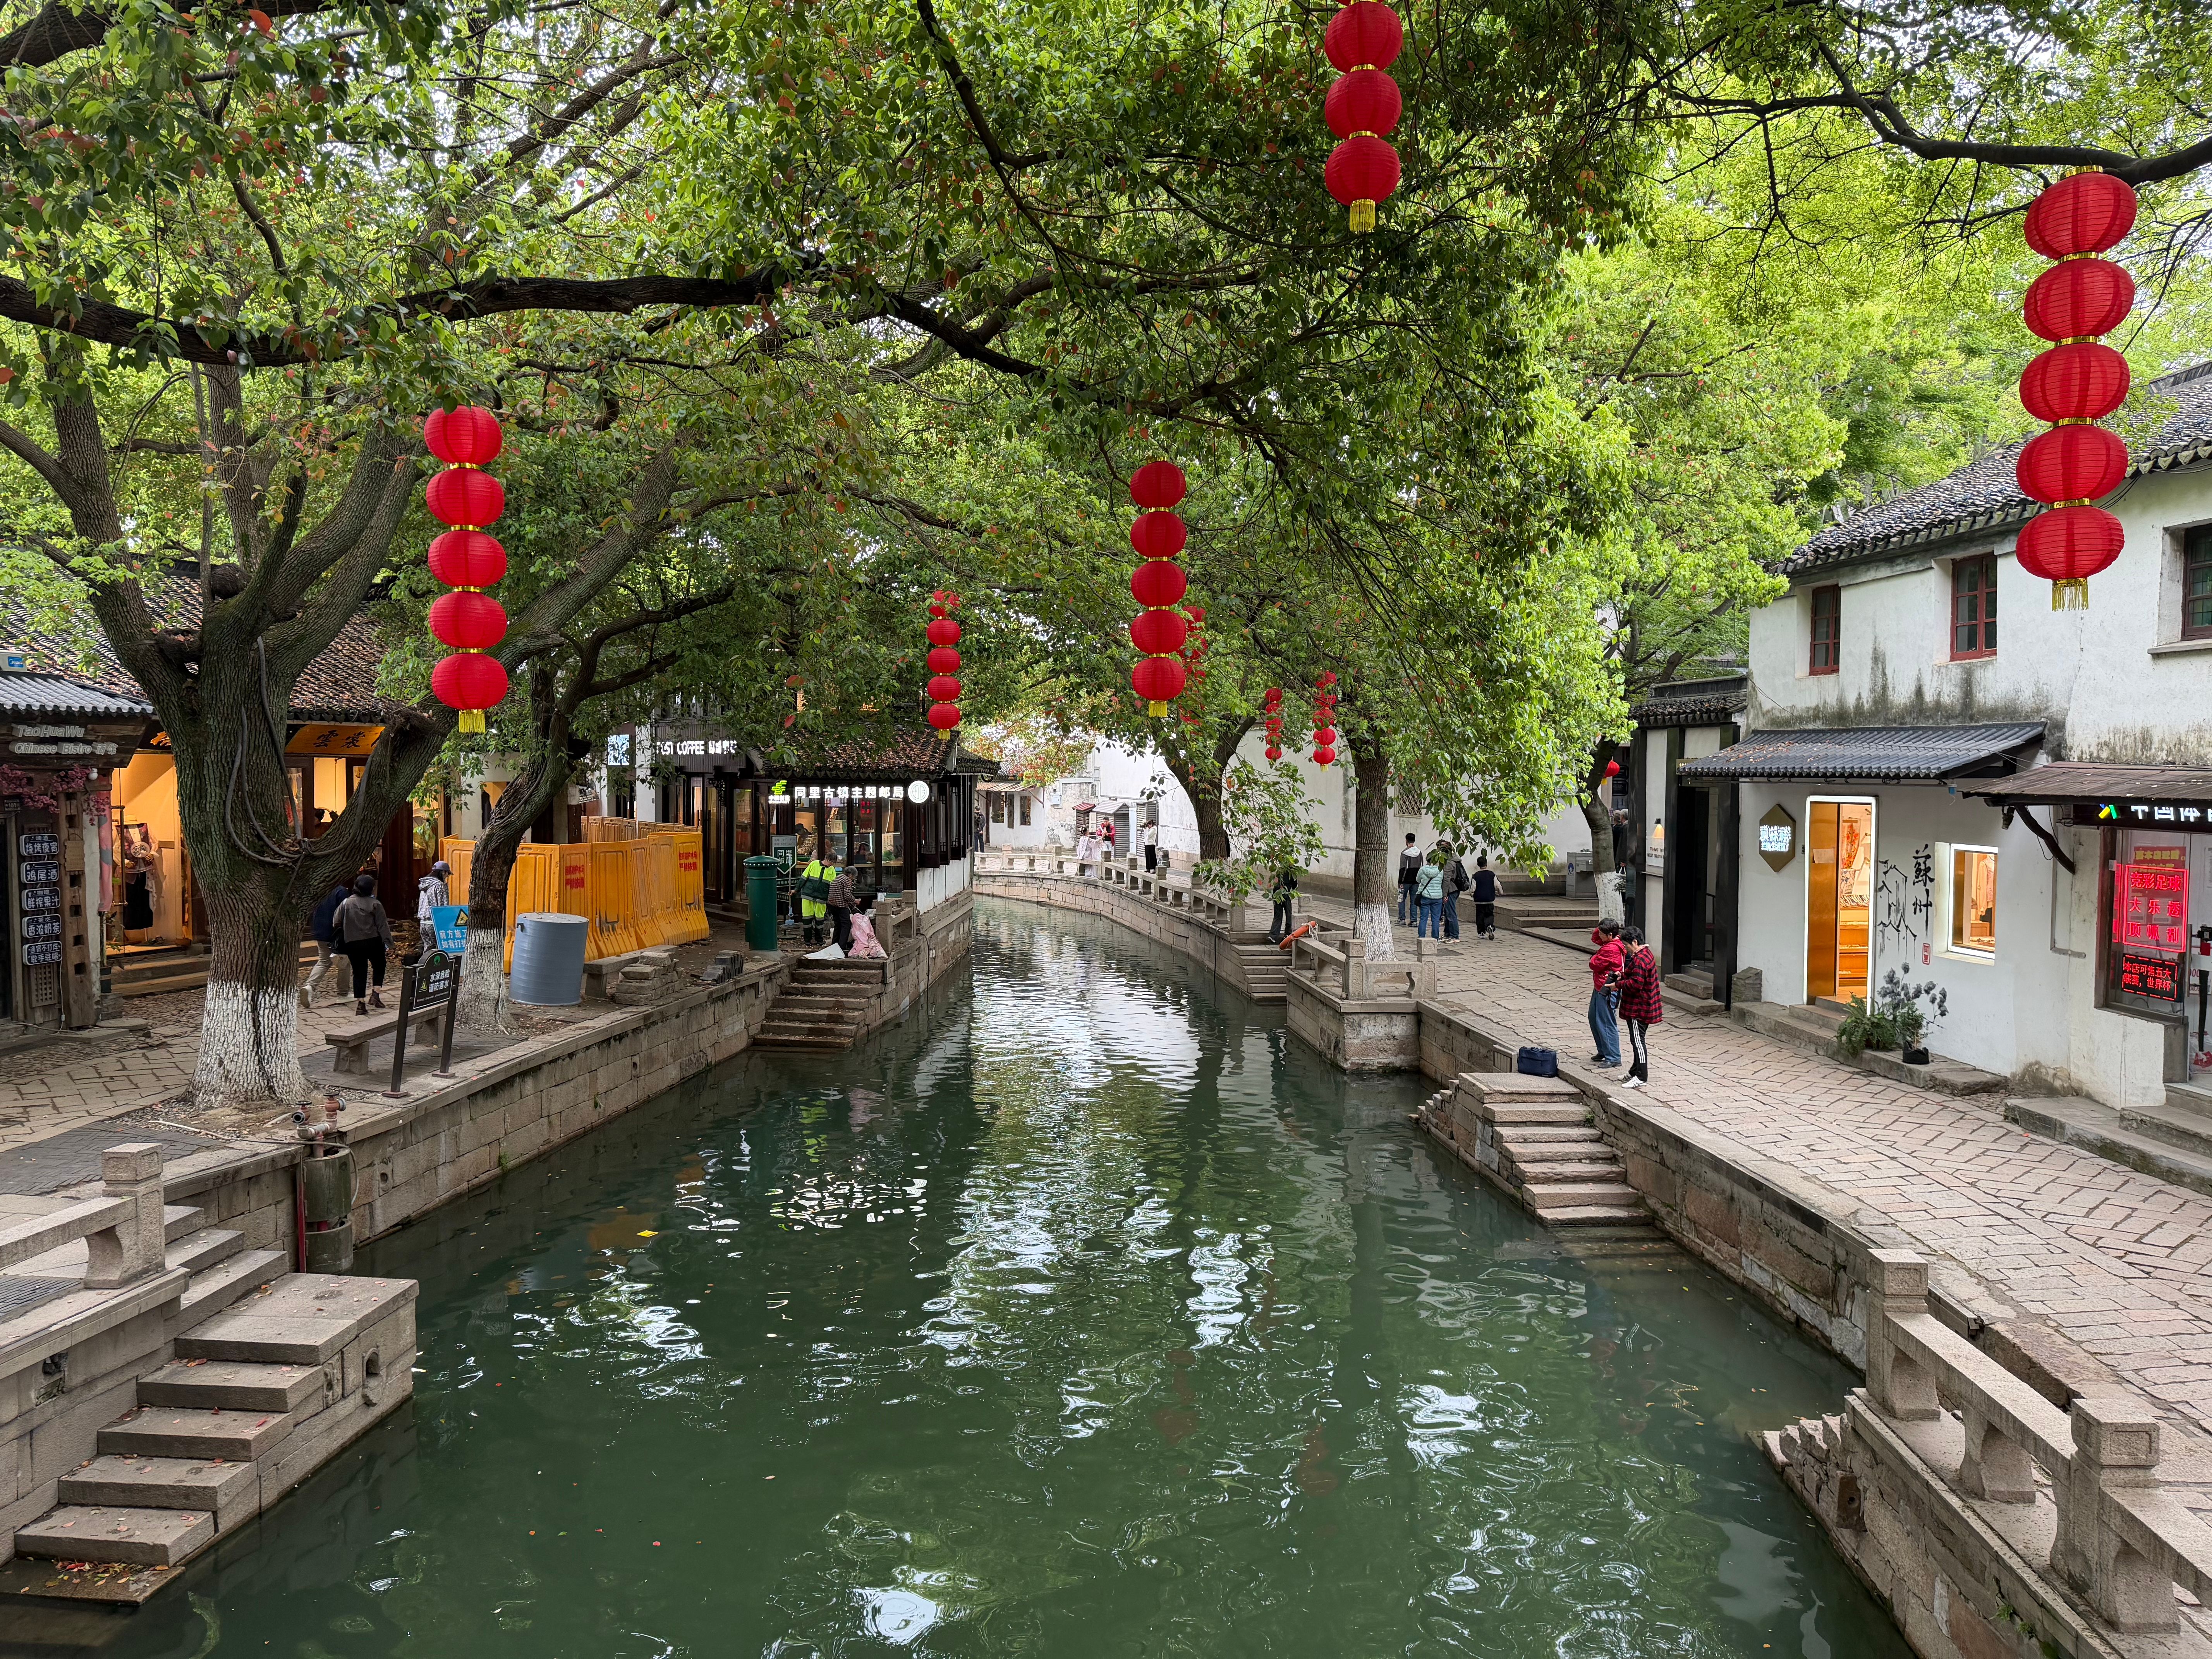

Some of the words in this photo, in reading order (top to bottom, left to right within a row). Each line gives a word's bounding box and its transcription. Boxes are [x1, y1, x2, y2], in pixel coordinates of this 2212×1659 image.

[17, 725, 85, 737] TaoHuaWu
[14, 743, 58, 754] Chinese
[62, 743, 92, 754] Bistro
[677, 740, 704, 755] COFFEE
[795, 786, 904, 799] 同里古镇主题邮局
[26, 842, 58, 854] 烧烤夜宵
[27, 869, 57, 881] 鸡尾酒
[2130, 871, 2181, 892] 竞彩足球
[27, 895, 59, 908] 鲜榨果汁
[2129, 896, 2181, 917] 大乐透
[28, 922, 60, 936] 香浓奶茶
[31, 952, 58, 963] 歌手驻唱
[429, 969, 450, 982] 水深危险
[2124, 961, 2172, 980] 本店可售五大
